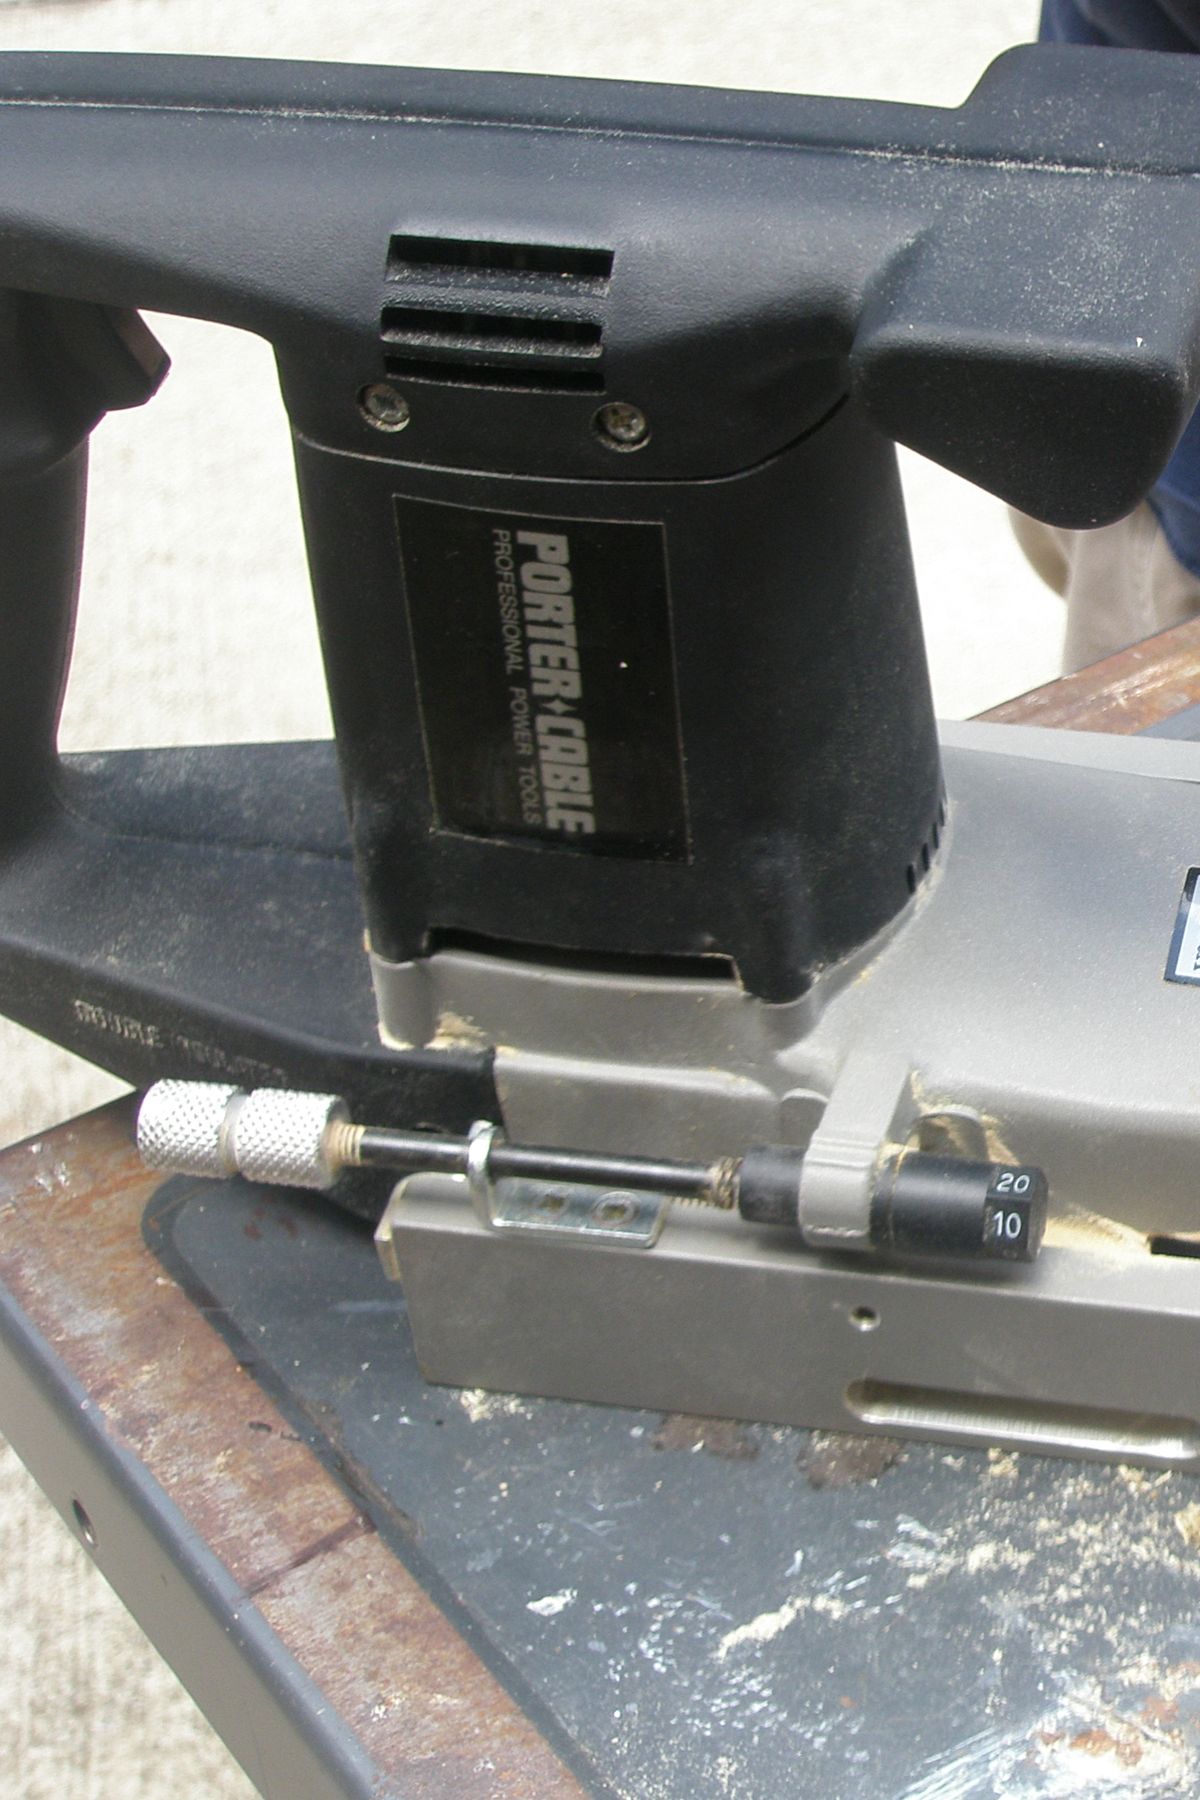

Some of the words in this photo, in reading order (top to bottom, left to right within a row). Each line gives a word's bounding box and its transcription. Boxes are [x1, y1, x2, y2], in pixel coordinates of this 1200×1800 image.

[492, 528, 525, 675] PROFESSIONAL
[509, 686, 533, 755] POWER
[519, 766, 542, 826] TOOLS
[996, 1172, 1031, 1194] 20
[993, 1210, 1022, 1239] 10
